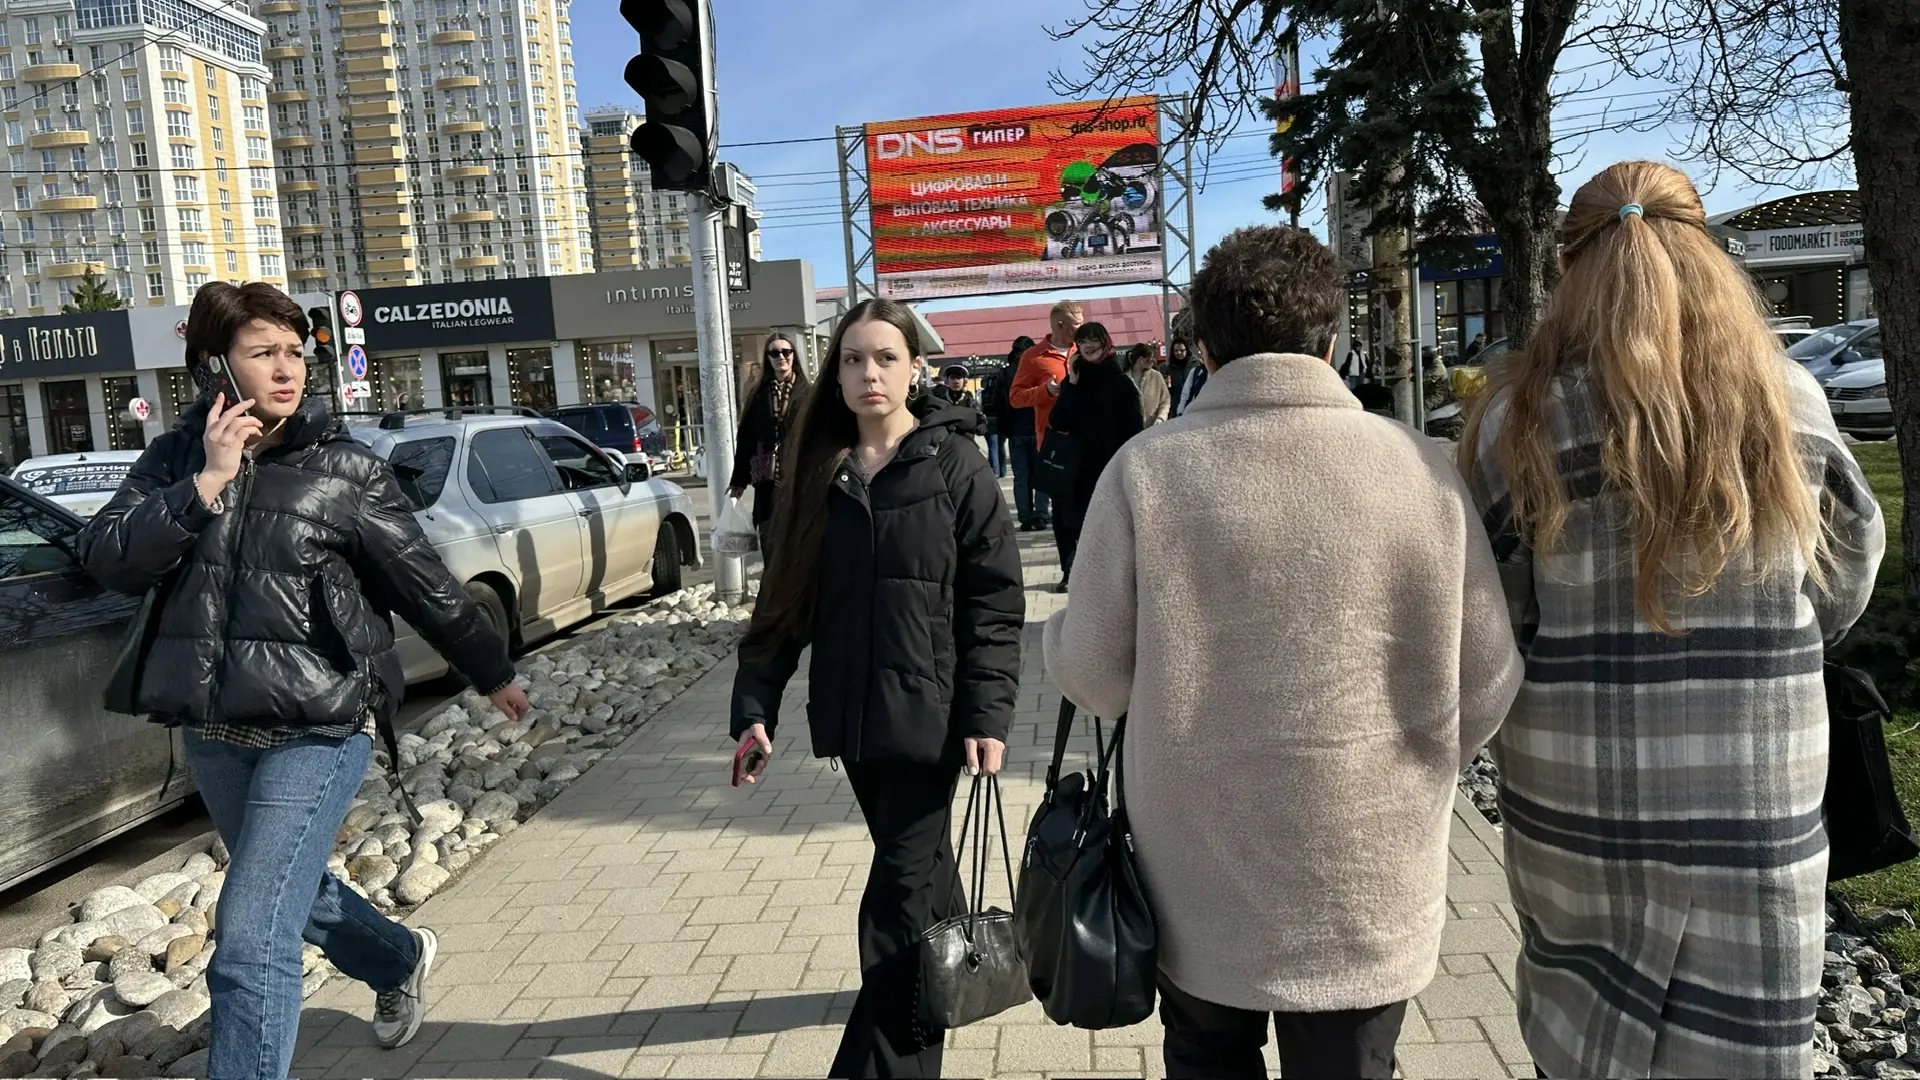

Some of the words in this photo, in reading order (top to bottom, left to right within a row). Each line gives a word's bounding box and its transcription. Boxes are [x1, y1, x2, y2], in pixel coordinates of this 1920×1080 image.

[1071, 116, 1146, 134] dns-shop.ru
[877, 127, 963, 160] DNS
[973, 127, 1025, 145] ГИПЕР
[911, 173, 992, 197] ЦИФРОВАЯ
[994, 173, 1008, 188] И
[893, 199, 960, 217] БЫТОВАЯ
[963, 194, 1028, 214] ТЕХНИКА
[922, 215, 1012, 235] АКСЕССУАРЫ
[1769, 232, 1832, 252] FOODMARKET
[432, 319, 468, 329] ITALIAN
[469, 316, 514, 327] LEGWEAR
[28, 326, 98, 361] Пальто
[67, 474, 105, 482] 7777
